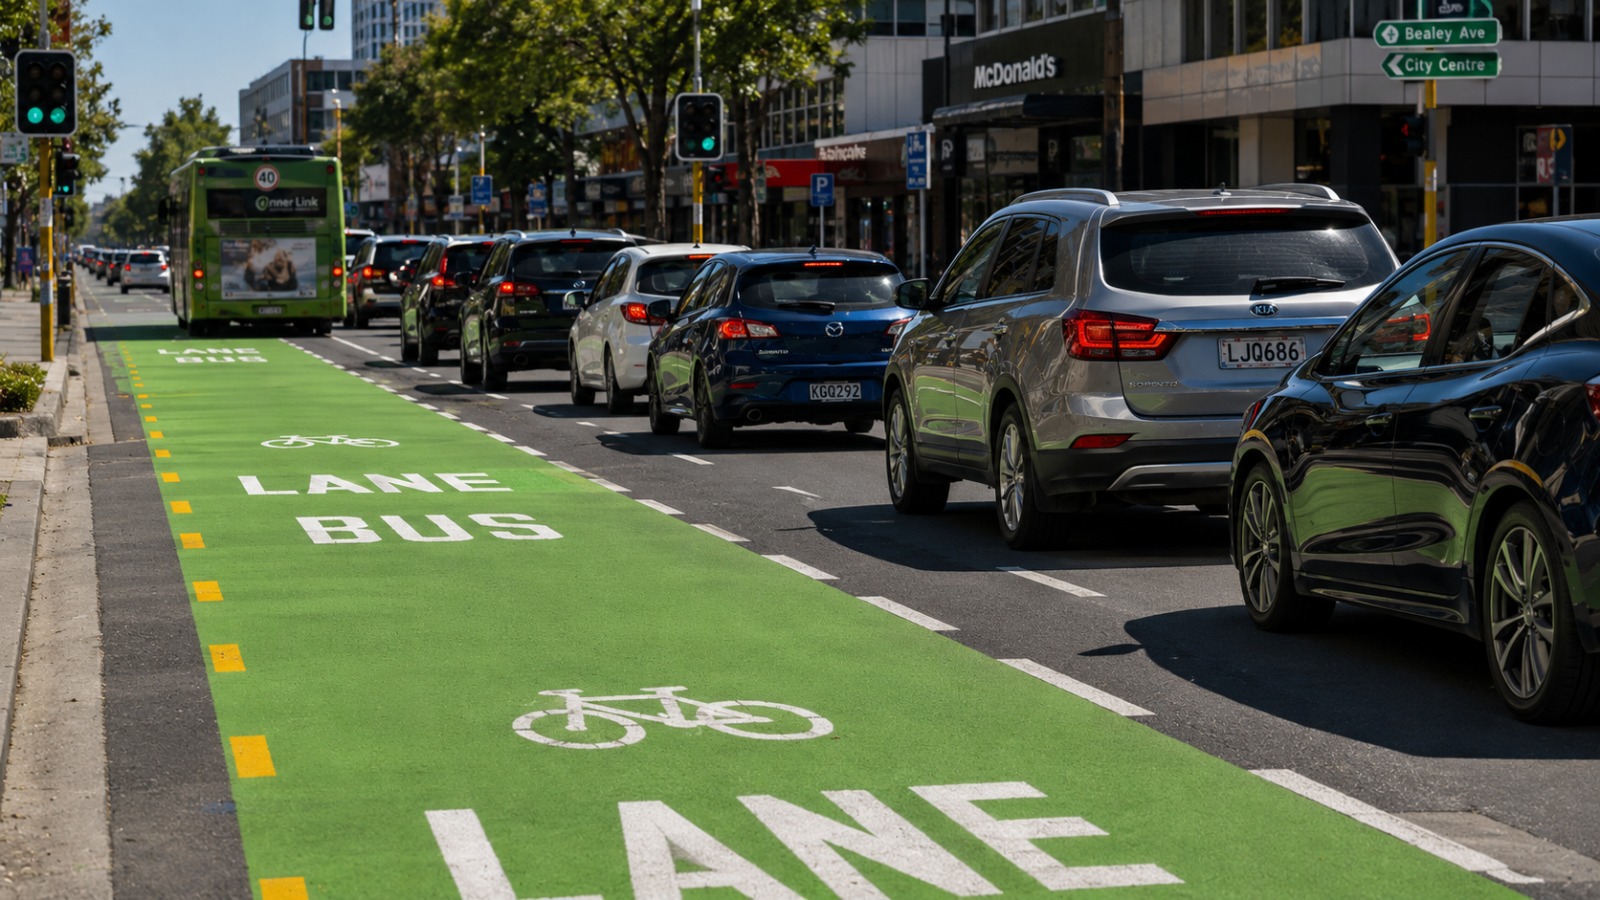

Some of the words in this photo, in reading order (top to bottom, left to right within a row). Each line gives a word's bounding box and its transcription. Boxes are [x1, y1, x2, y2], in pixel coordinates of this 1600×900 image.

[1405, 26, 1453, 42] Bealey
[1460, 26, 1485, 39] Ave
[974, 53, 1056, 89] McDonald's
[1405, 58, 1433, 74] City
[1439, 58, 1485, 71] Centre
[258, 171, 276, 184] 40
[816, 176, 828, 192] P
[295, 196, 318, 207] Link
[1255, 305, 1275, 314] KIA
[157, 347, 260, 355] LANE
[1228, 341, 1299, 362] LJQ686
[811, 384, 859, 398] KGQ292
[237, 472, 513, 495] LANE
[295, 513, 564, 544] BUS
[424, 781, 1186, 900] LANE
